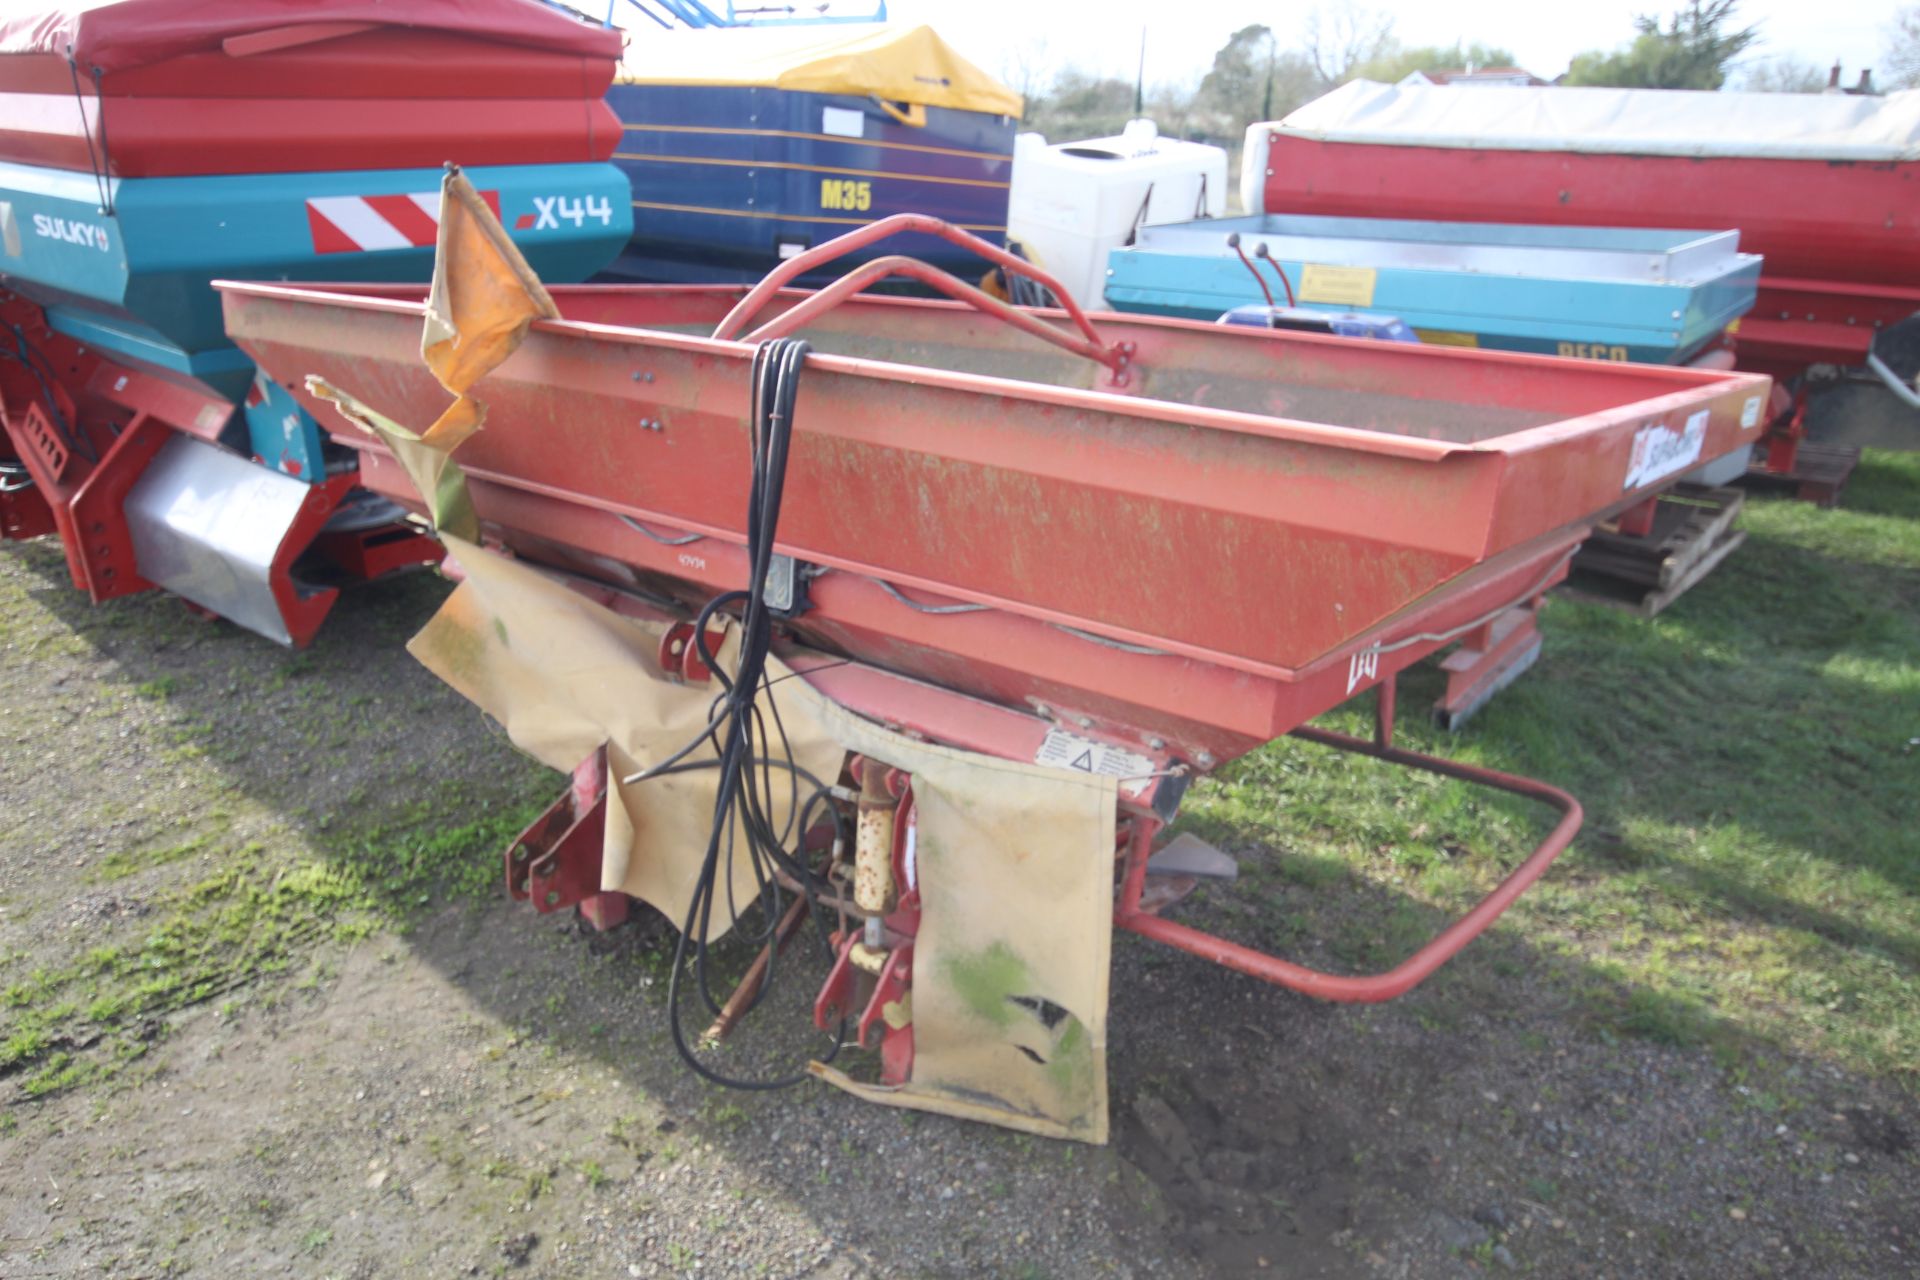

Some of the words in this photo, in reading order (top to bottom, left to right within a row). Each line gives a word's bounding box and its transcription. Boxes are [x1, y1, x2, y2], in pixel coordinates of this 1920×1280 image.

[532, 194, 613, 230] X44
[821, 179, 872, 211] M35
[32, 213, 95, 248] SULKY
